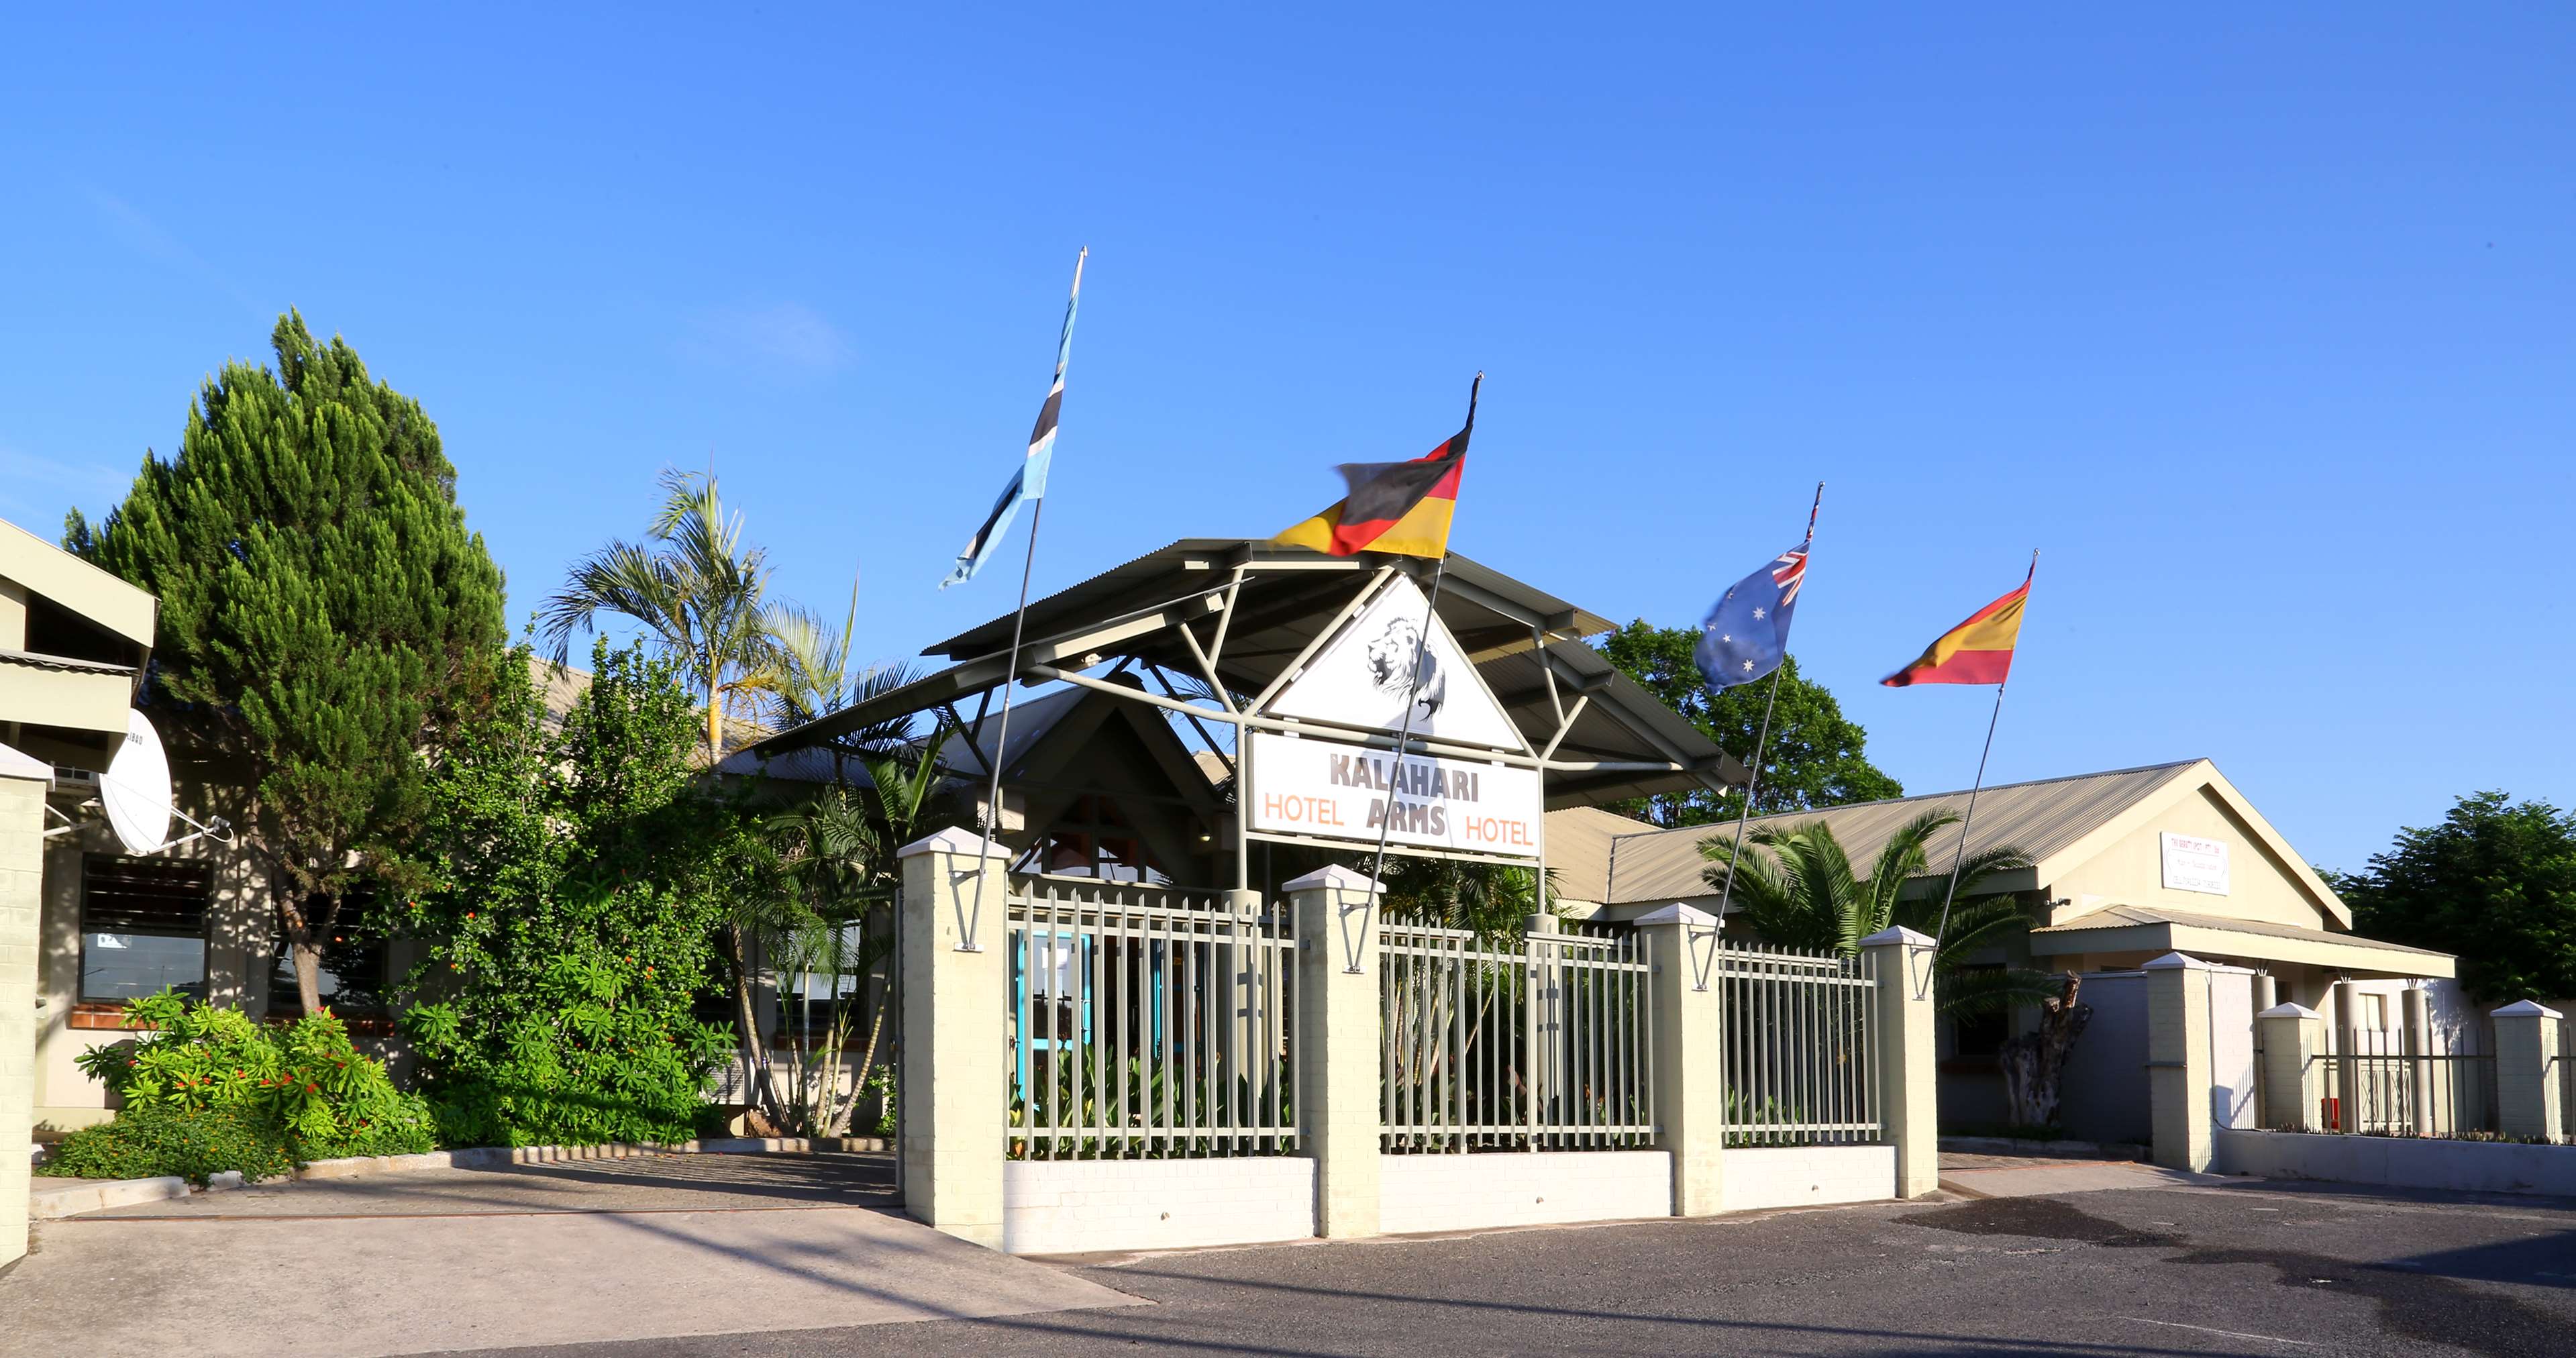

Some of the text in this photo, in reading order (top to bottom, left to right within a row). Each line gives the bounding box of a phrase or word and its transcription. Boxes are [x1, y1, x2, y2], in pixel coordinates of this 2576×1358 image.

[1330, 753, 1478, 802] KALAHARI
[1265, 792, 1344, 827] HOTEL
[1366, 798, 1445, 836] ARMS
[1466, 816, 1533, 847] HOTEL
